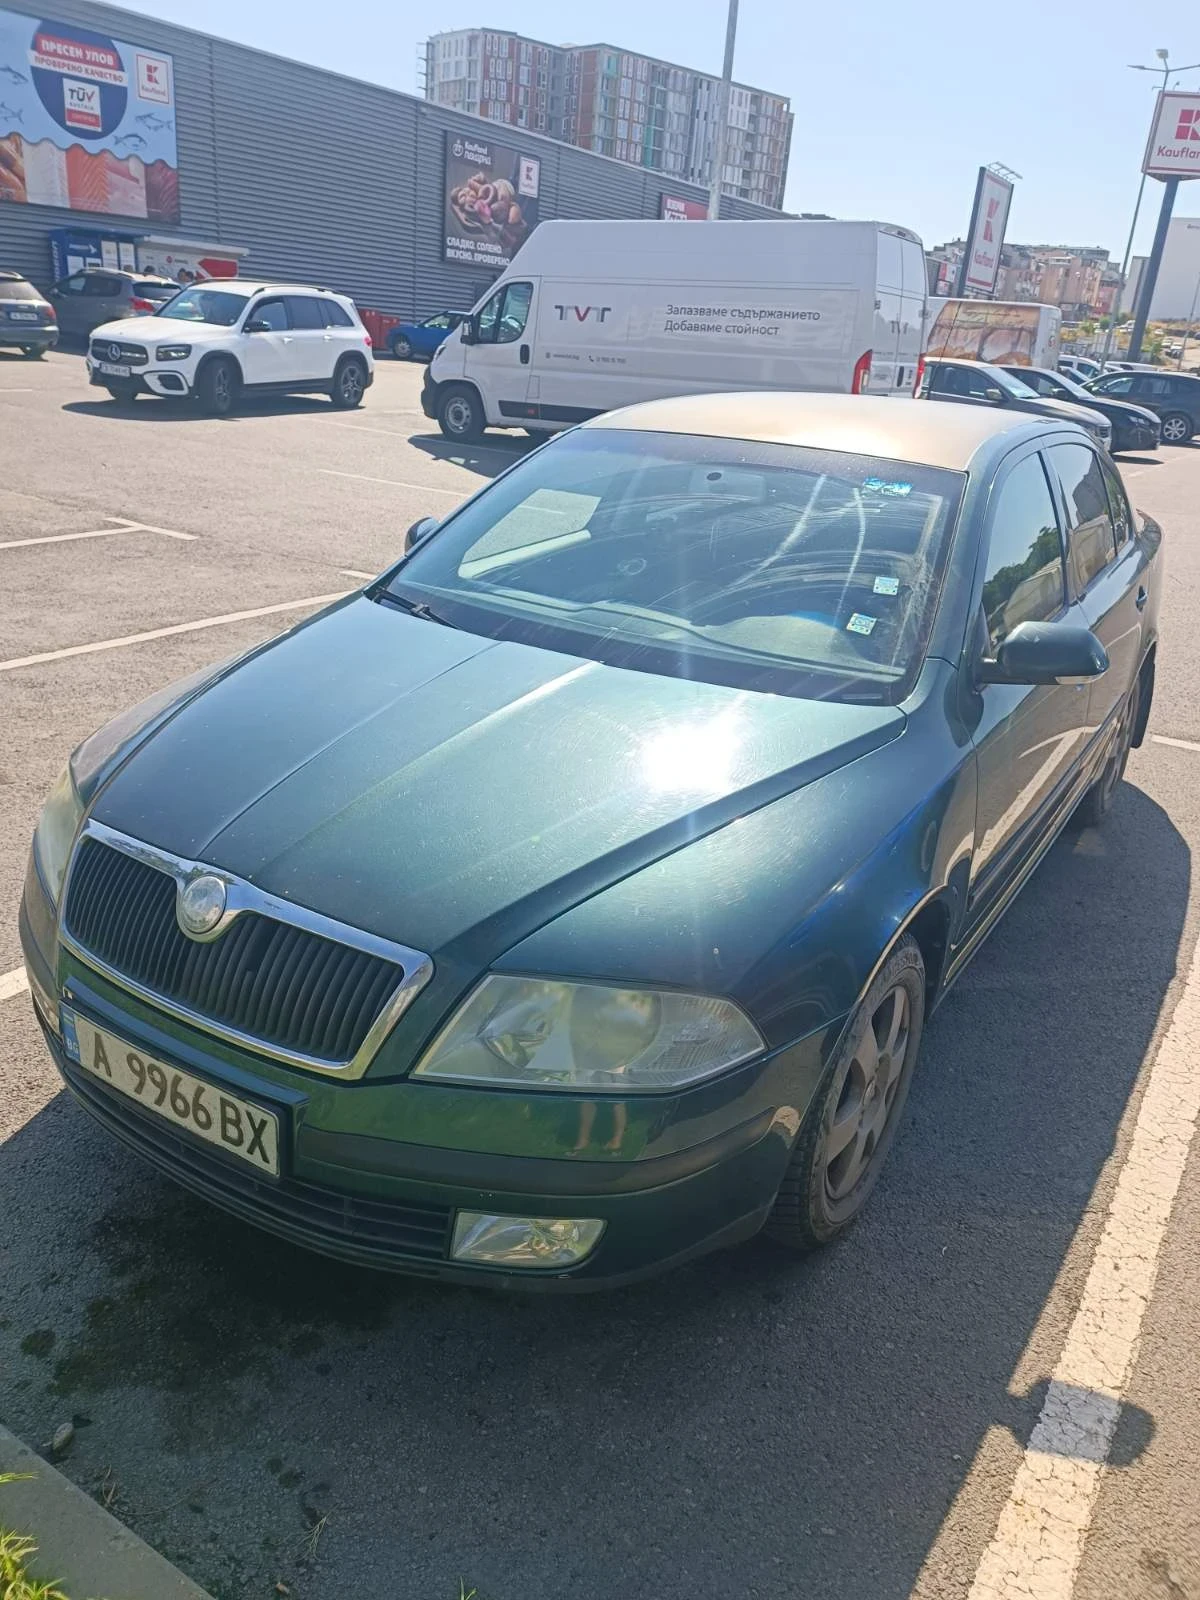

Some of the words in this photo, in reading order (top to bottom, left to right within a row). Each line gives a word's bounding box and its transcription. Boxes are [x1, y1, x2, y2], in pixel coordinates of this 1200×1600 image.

[41, 39, 83, 59] ПРЕСЕН
[34, 55, 82, 74] ПРОВЕРЕНО
[84, 67, 123, 83] КАЧЕСТВО
[68, 86, 96, 102] TÜV
[554, 304, 612, 323] TVT
[666, 304, 728, 317] Запазваме
[730, 307, 821, 321] съдържанието
[664, 319, 722, 333] Добавяме
[725, 323, 780, 336] стойност
[93, 1031, 112, 1078] A
[126, 1052, 213, 1131] 9966
[219, 1096, 271, 1164] BX
